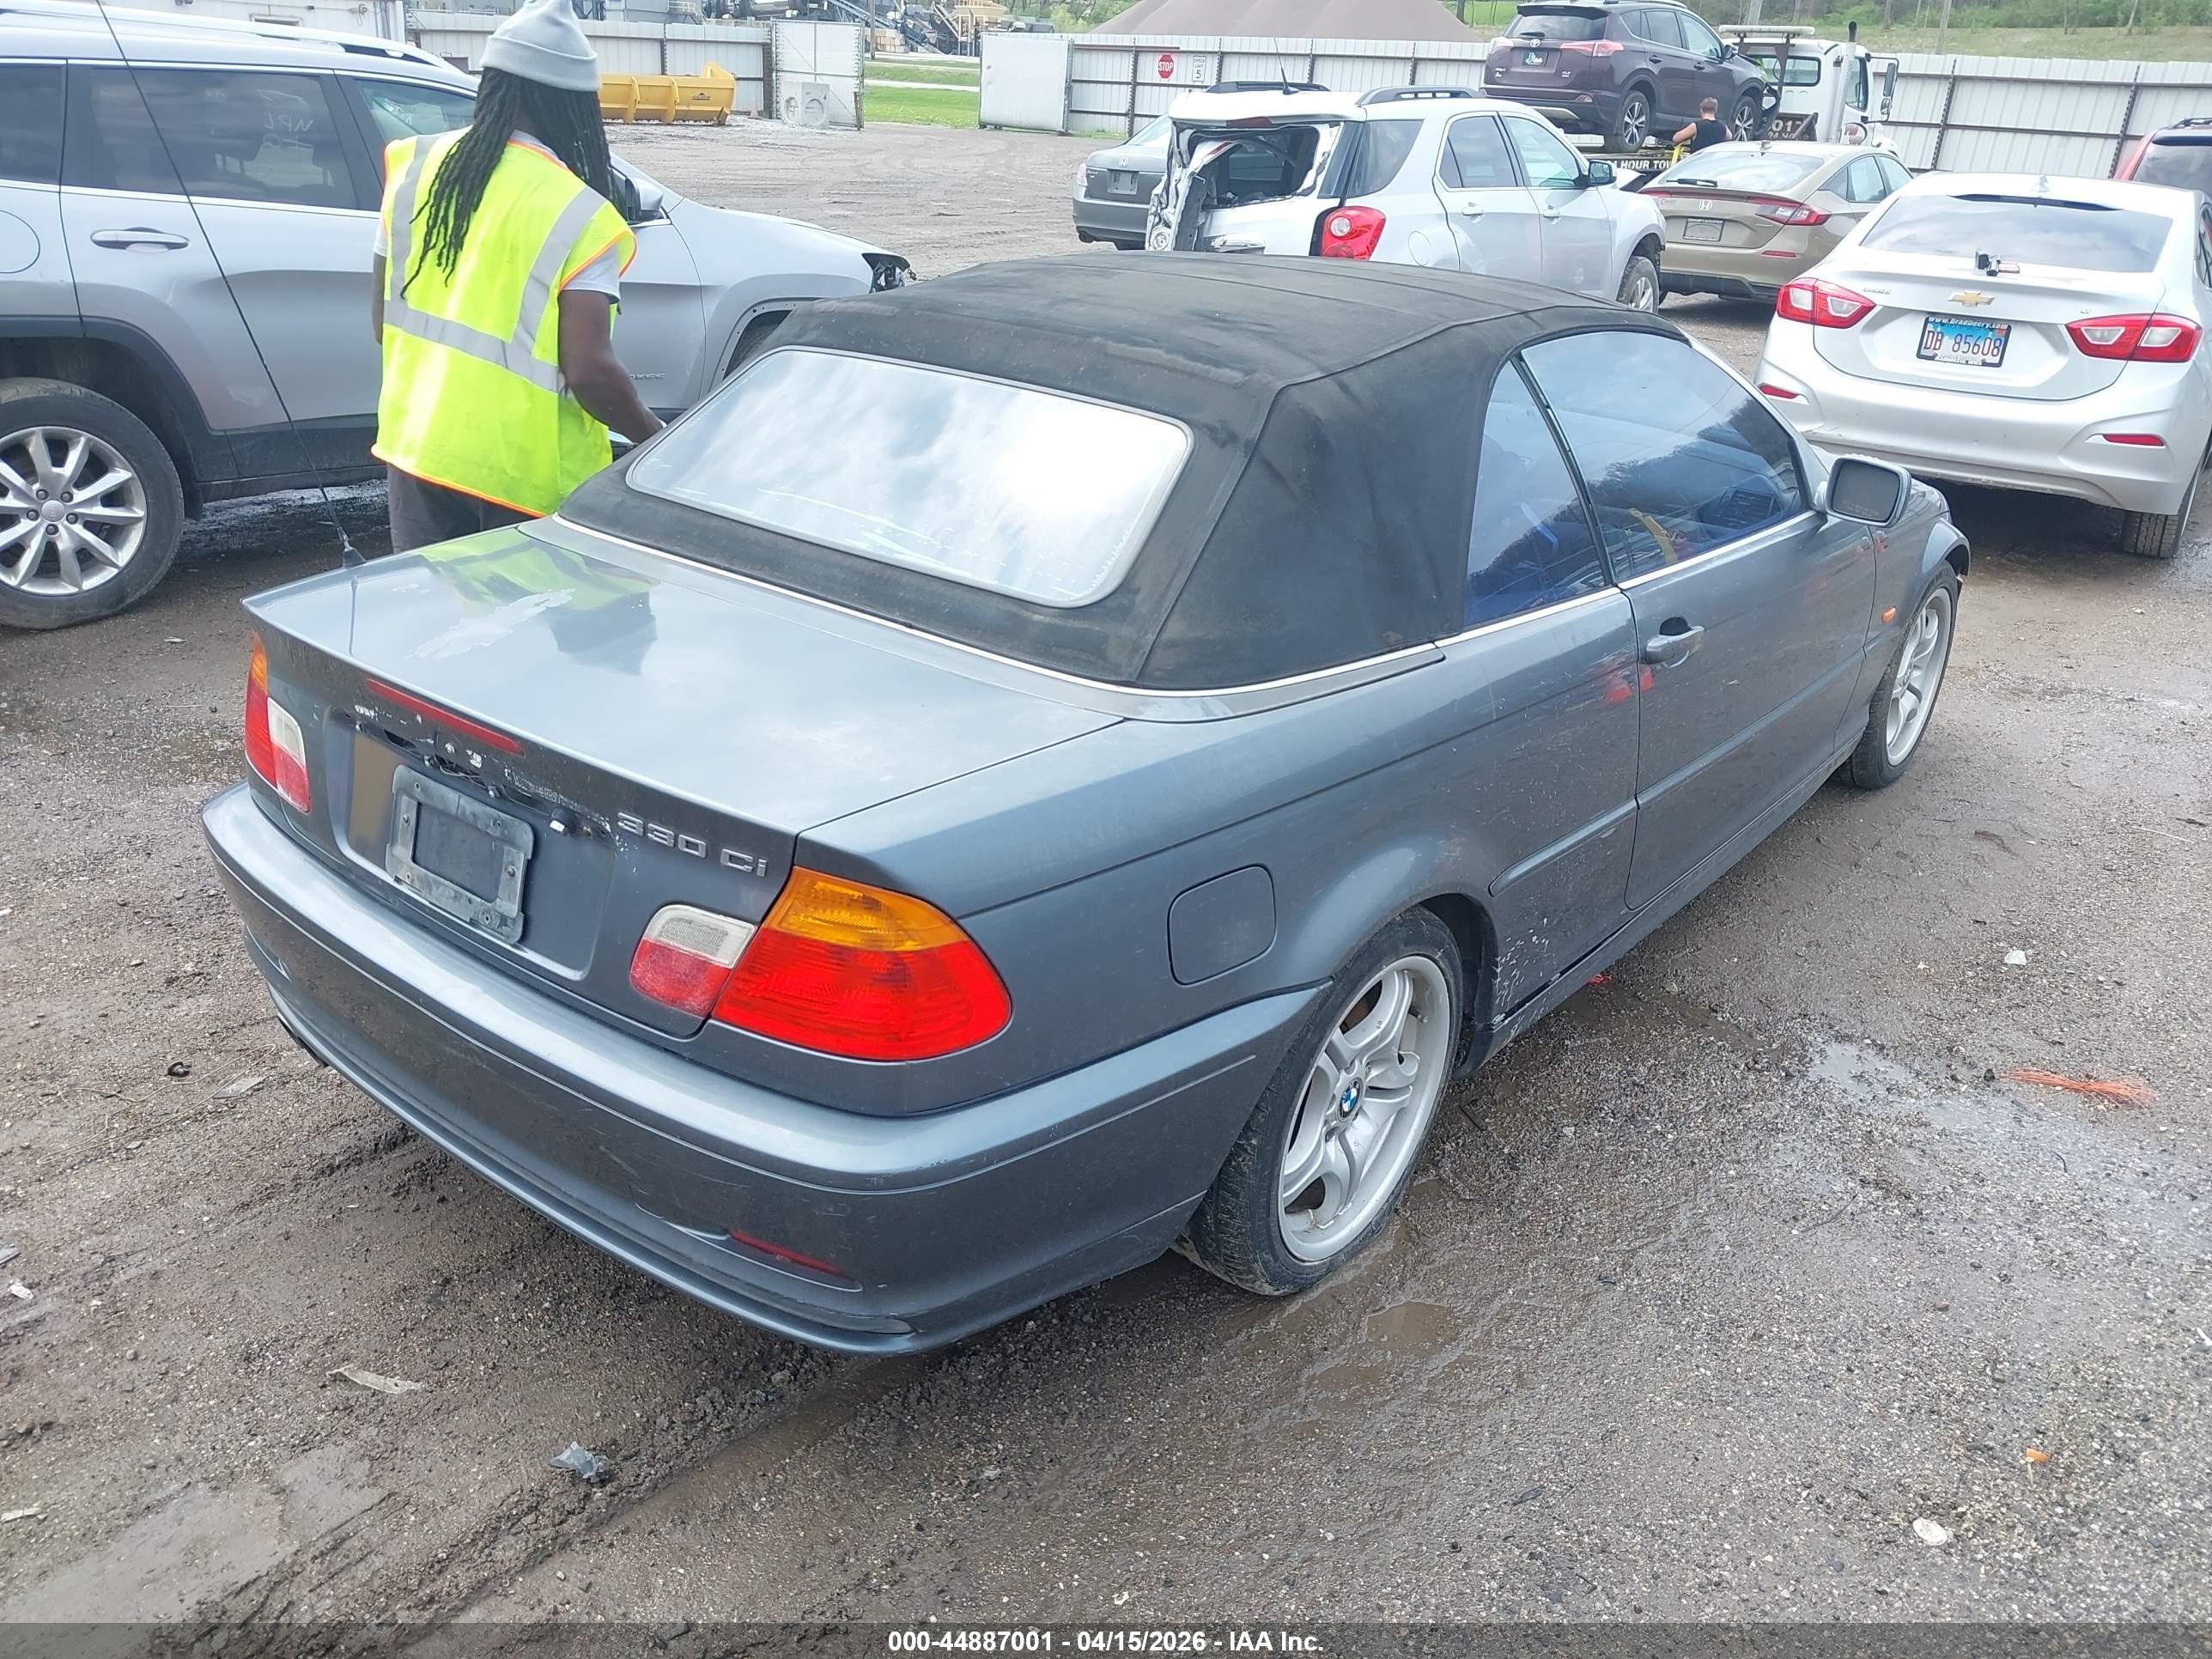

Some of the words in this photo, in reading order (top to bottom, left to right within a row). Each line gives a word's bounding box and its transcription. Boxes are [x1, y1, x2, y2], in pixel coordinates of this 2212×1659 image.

[1158, 61, 1174, 71] STOP
[1195, 70, 1202, 79] 5
[1620, 160, 1650, 169] HOUR
[1923, 330, 1944, 350] DB
[1952, 333, 2002, 357] 85608
[617, 812, 708, 858] 330
[720, 849, 768, 878] Ci
